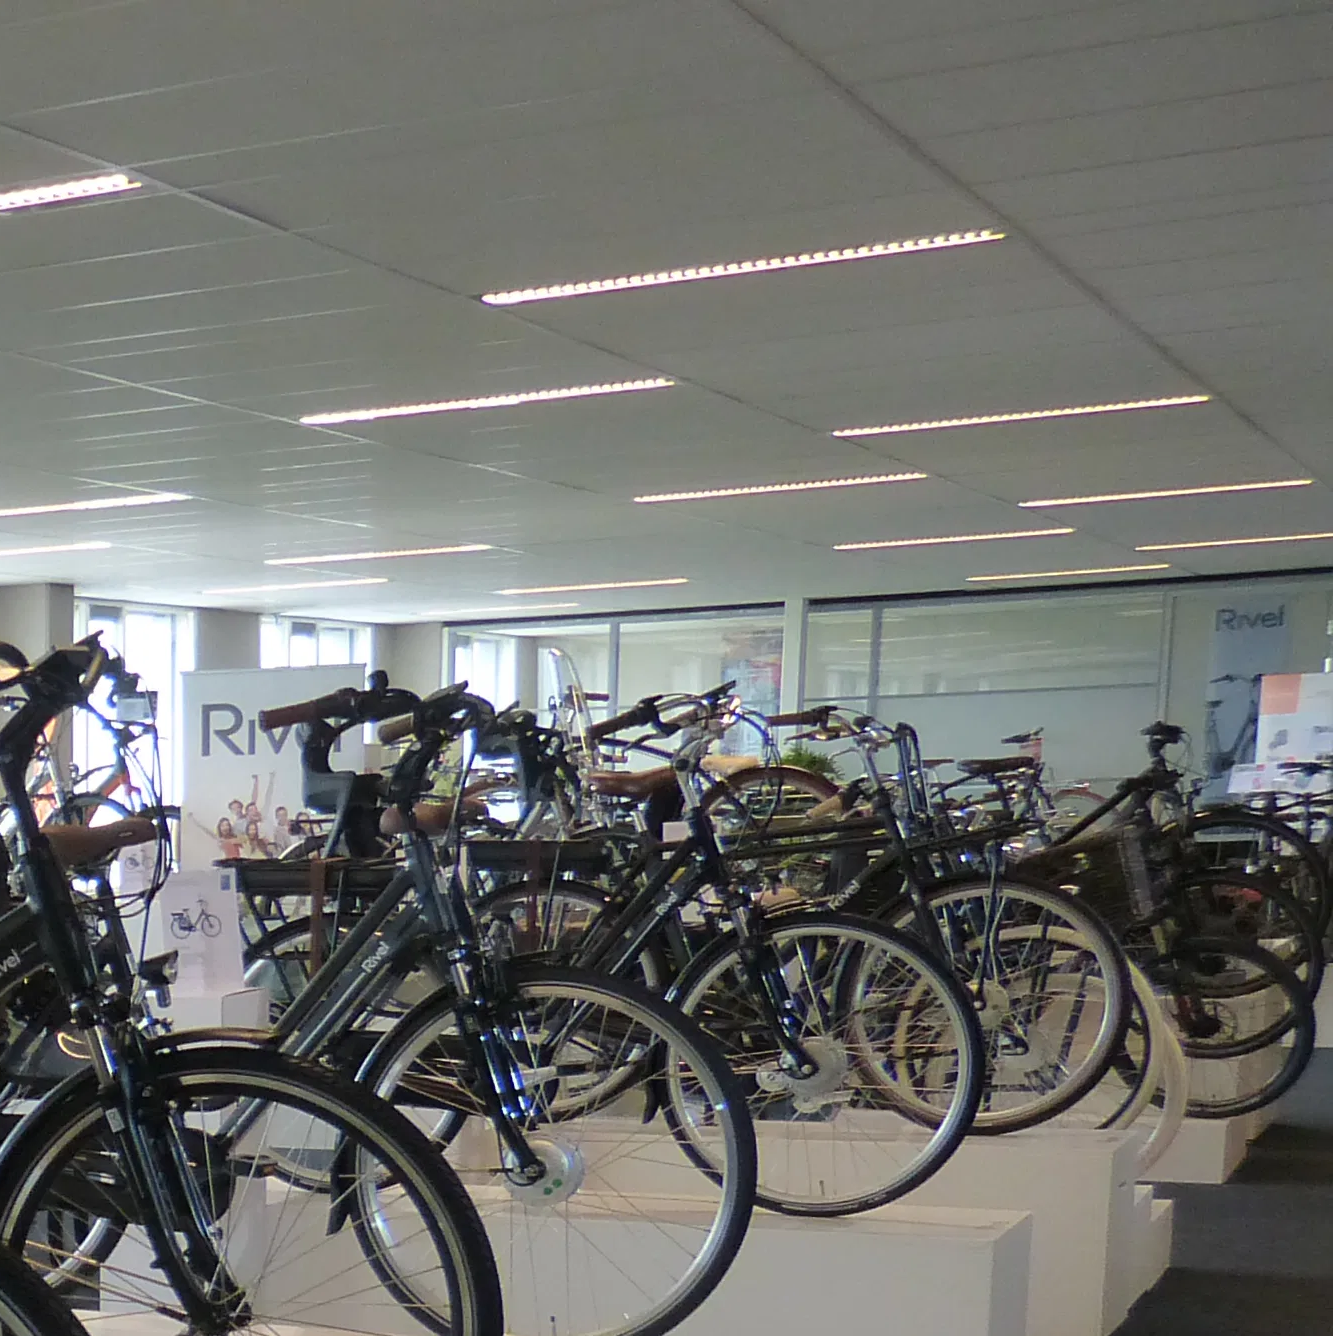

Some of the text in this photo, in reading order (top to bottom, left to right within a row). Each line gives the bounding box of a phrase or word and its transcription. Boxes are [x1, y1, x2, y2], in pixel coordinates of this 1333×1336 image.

[1215, 604, 1285, 632] Rivel
[201, 703, 341, 757] Rivl
[361, 941, 390, 973] Rivel
